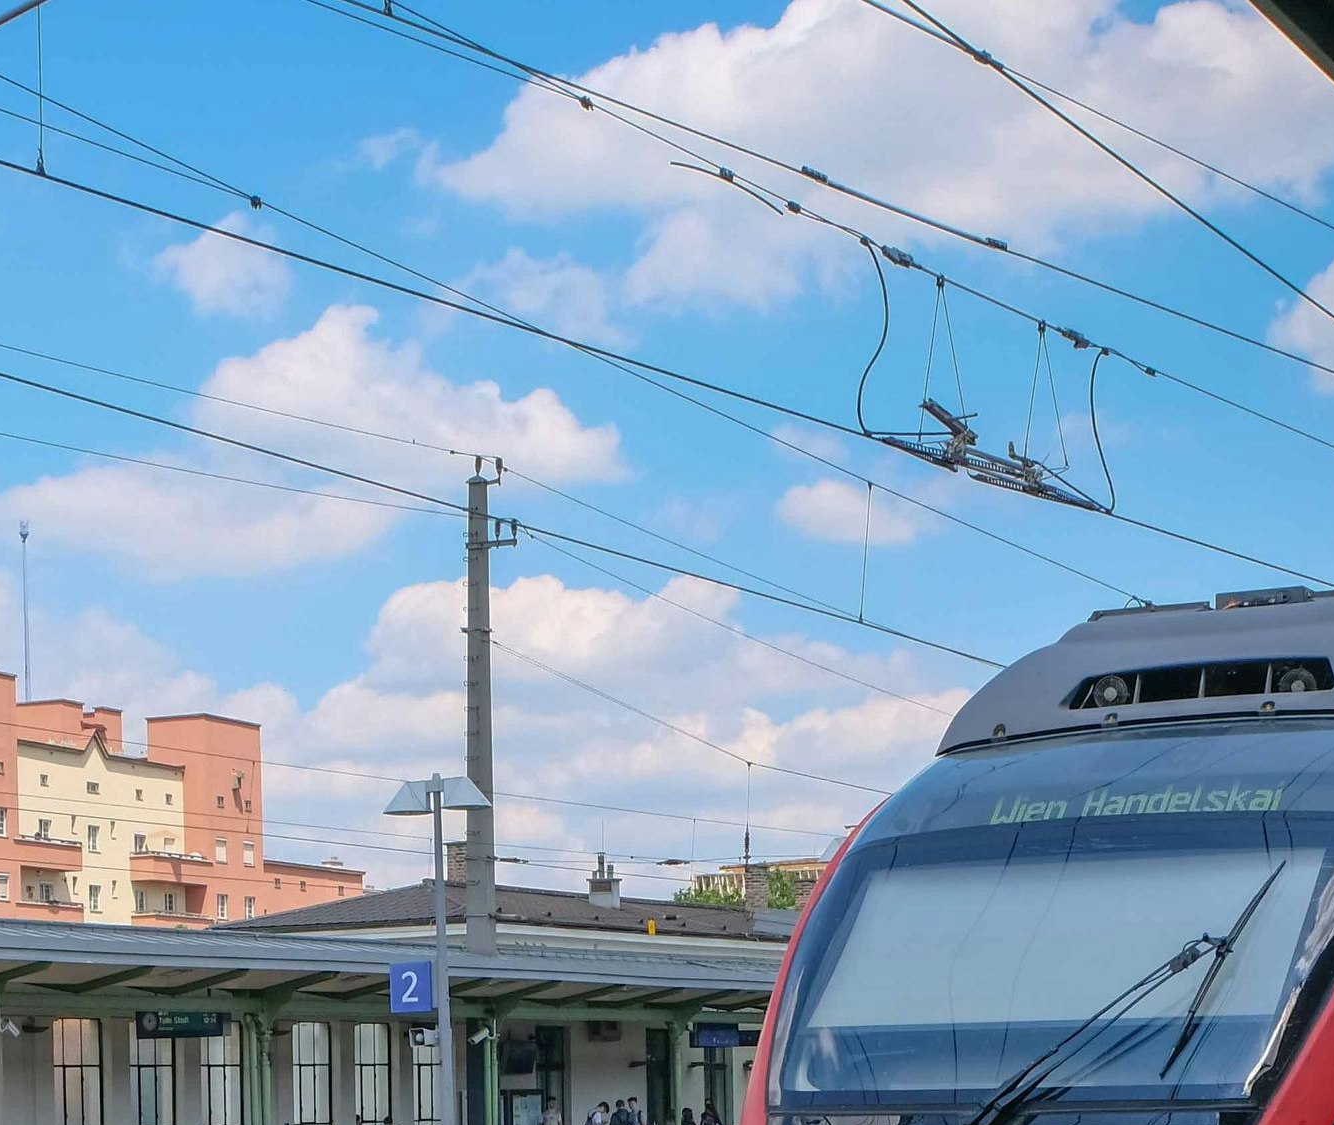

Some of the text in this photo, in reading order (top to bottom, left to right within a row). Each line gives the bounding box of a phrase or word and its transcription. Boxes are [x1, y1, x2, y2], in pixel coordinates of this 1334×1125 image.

[989, 782, 1286, 826] Wien Handelskai
[401, 970, 419, 1003] 2
